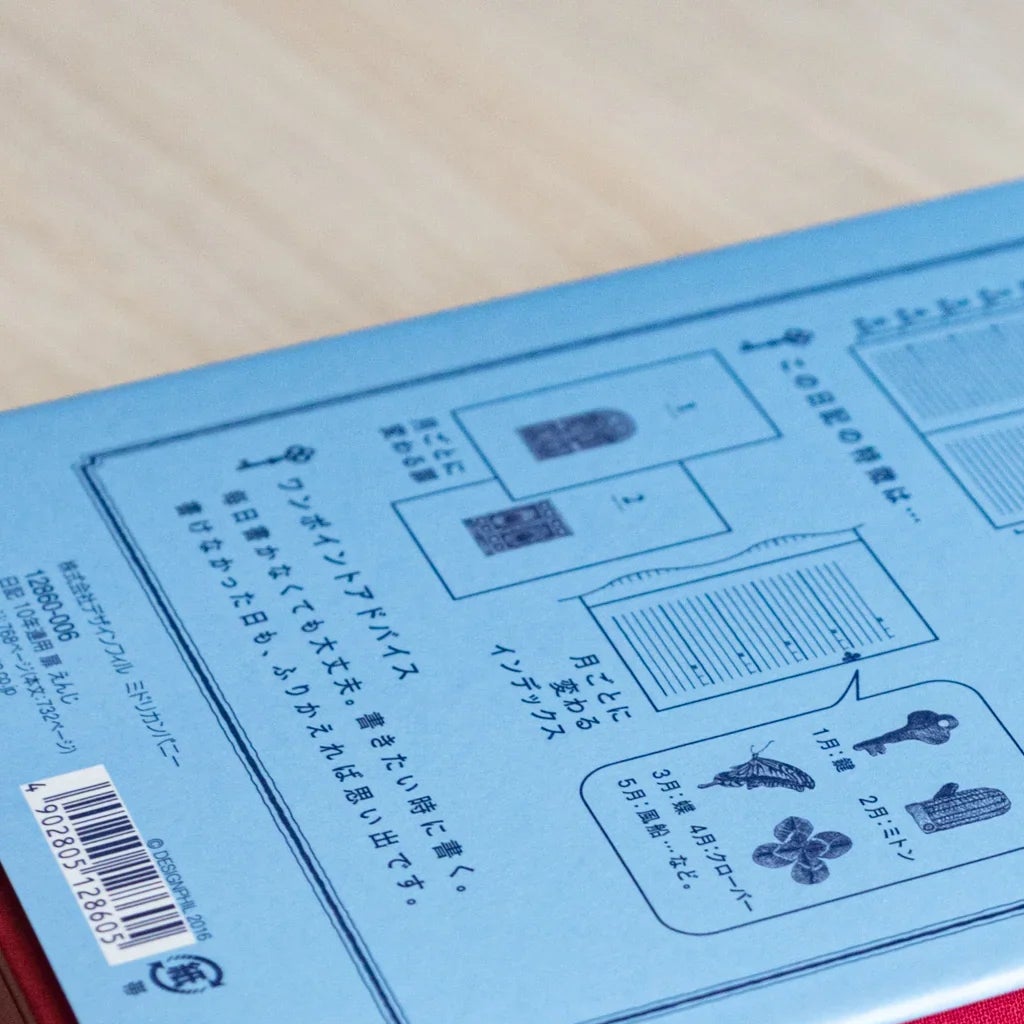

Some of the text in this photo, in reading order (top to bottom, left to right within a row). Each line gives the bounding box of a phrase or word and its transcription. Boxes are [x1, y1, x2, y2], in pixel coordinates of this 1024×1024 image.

[25, 569, 79, 641] 12860-006
[277, 477, 419, 680] ワンポイントアドバイス
[47, 671, 78, 704] えんじ
[57, 559, 179, 767] 株式会社デザインフィル ミドリカンパニー
[174, 500, 424, 905] 書けなかった日も、ふりかえれば思い出です。
[223, 490, 474, 892] 毎日書かなくても大丈夫。書きたい時に書く。
[490, 644, 565, 740] インデックス
[548, 678, 600, 730] 変わる
[569, 653, 631, 722] 月ごとに
[34, 803, 83, 870] 902805
[72, 876, 124, 945] 128605
[152, 849, 196, 914] DESIGNPHIL
[186, 913, 212, 941] 2016
